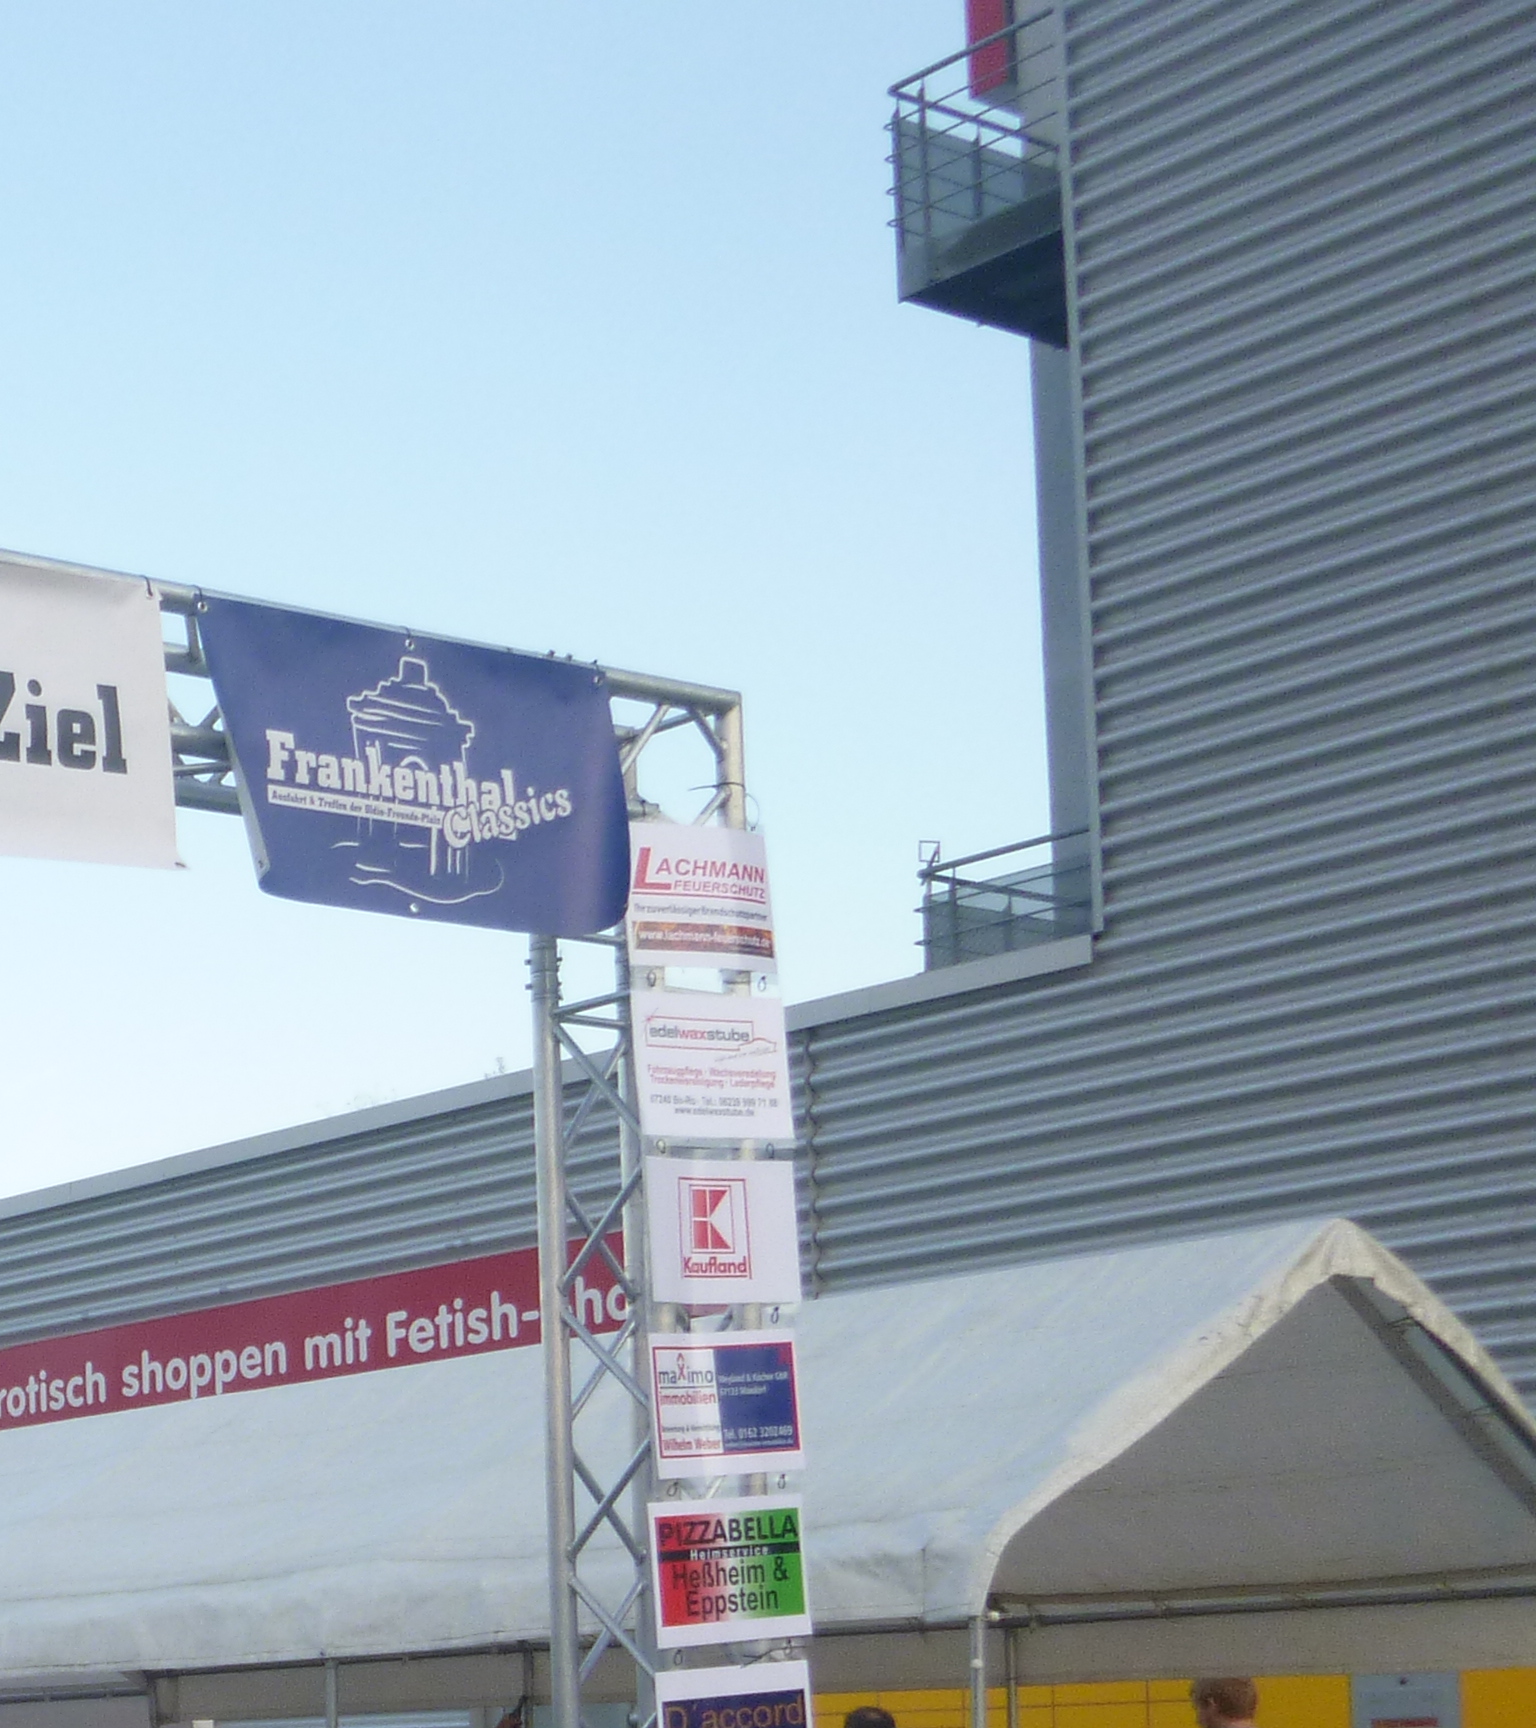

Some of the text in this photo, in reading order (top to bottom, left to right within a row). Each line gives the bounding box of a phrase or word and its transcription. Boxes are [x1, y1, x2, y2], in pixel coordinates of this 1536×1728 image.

[266, 729, 516, 808] Frankenthal
[444, 786, 572, 849] Classics
[633, 847, 765, 890] LACHMANN
[674, 880, 766, 899] FEUERSCHUTZ
[649, 1025, 750, 1042] edelwaxstube
[684, 1256, 747, 1273] Kaufland
[122, 1341, 287, 1399] shoppen
[304, 1317, 371, 1370] mit
[659, 1515, 798, 1546] PIZZABELLA
[690, 1546, 769, 1561] Heimservice
[672, 1556, 789, 1589] Heßheim &
[686, 1584, 778, 1621] Eppstein
